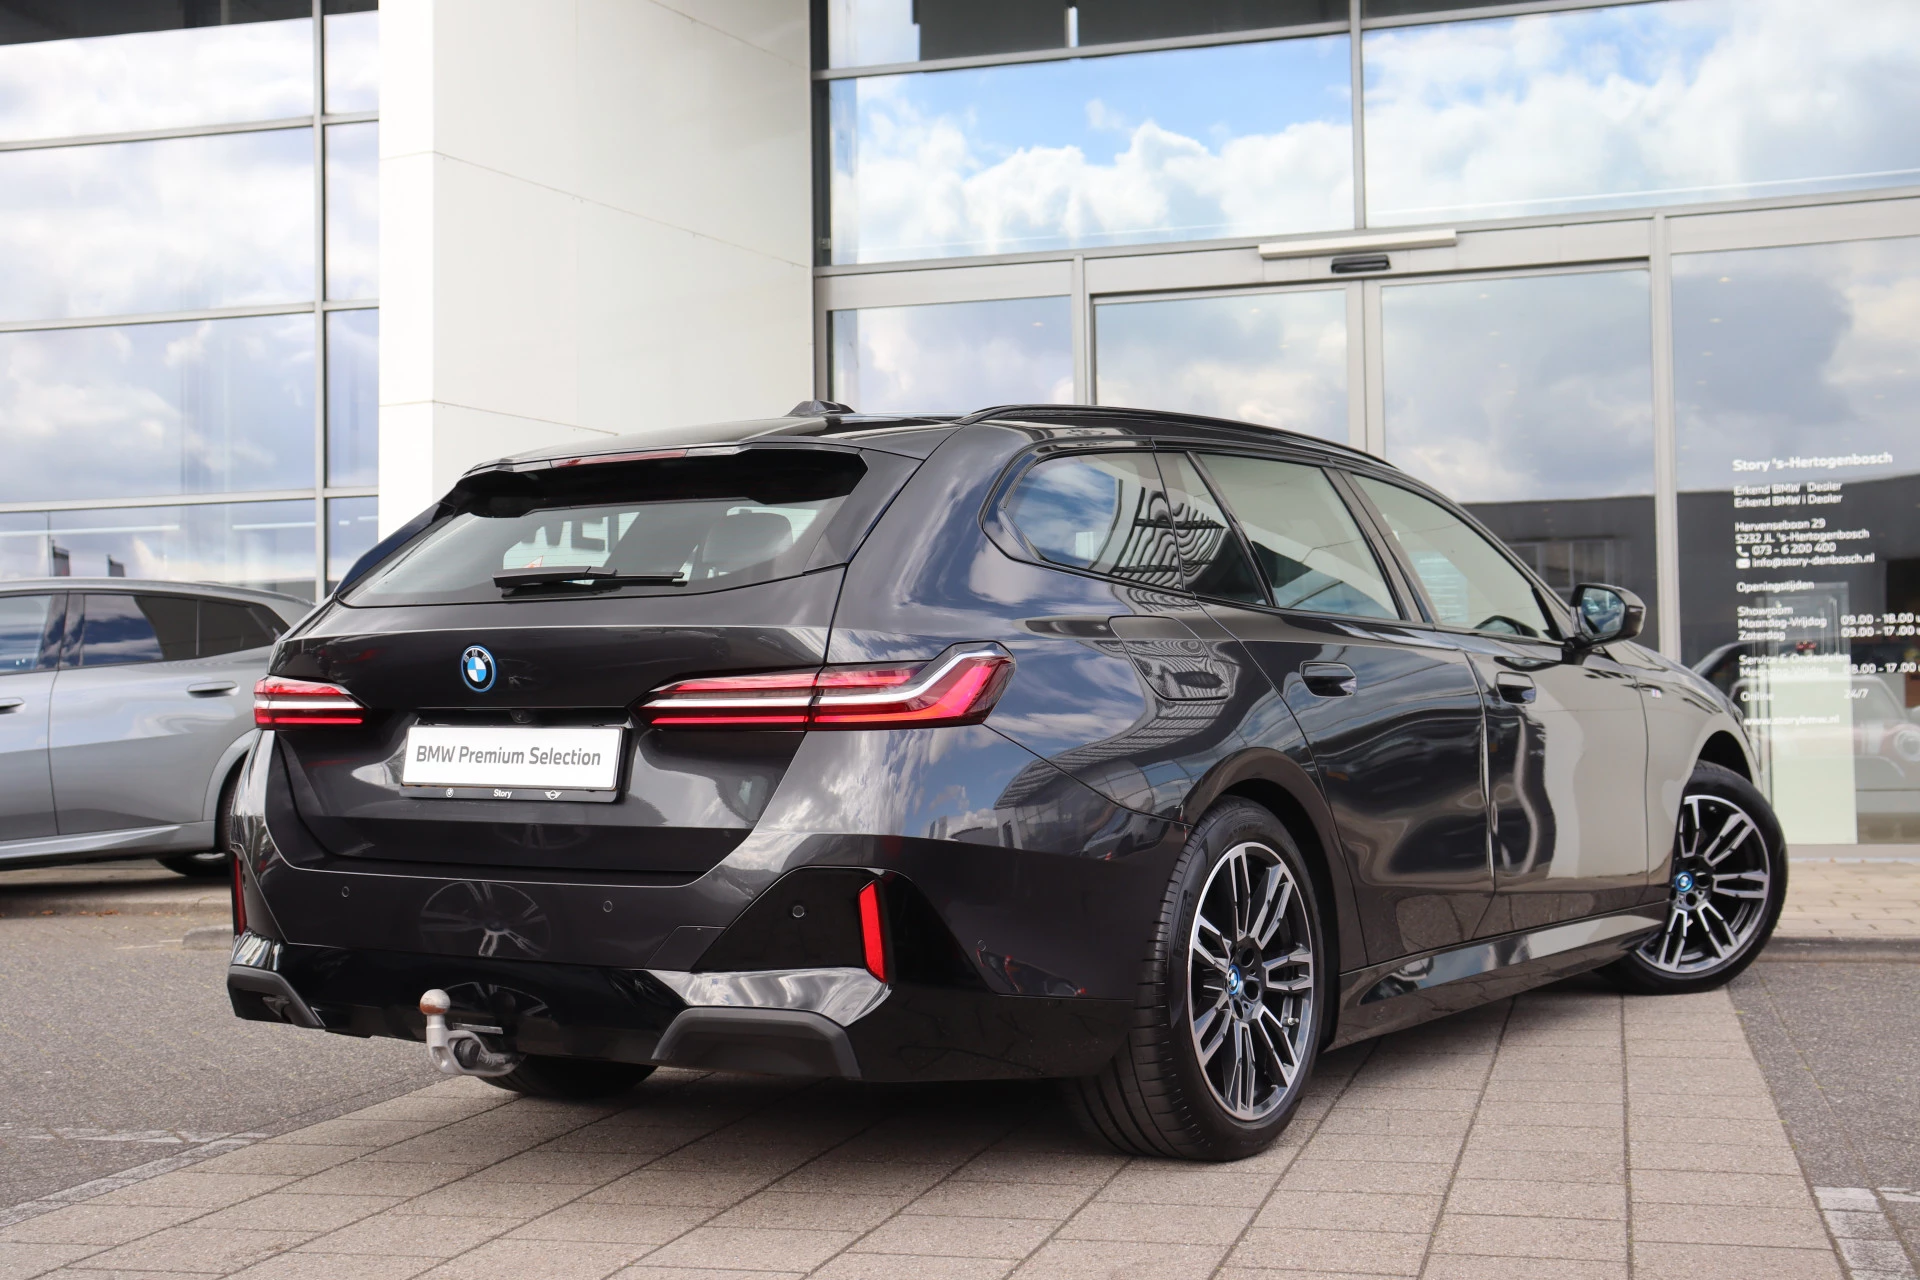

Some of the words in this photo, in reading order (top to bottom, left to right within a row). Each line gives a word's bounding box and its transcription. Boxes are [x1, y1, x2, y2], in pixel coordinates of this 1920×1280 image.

[1732, 459, 1770, 472] Story
[1772, 451, 1893, 470] 's-Hertogenbosch
[1733, 485, 1770, 496] Erkend
[1772, 483, 1800, 494] BMW
[1807, 481, 1842, 493] Dealer
[1734, 497, 1771, 508] Erkend
[1772, 495, 1801, 507] BMW
[1807, 493, 1842, 505] Dealer
[1735, 520, 1810, 532] Hervensebaan
[1811, 518, 1826, 529] 29
[1735, 533, 1761, 544] 5232
[1763, 533, 1775, 544] JL
[1776, 528, 1870, 544] 's-Hertogenbosch
[1752, 544, 1772, 556] 073
[1781, 543, 1789, 554] 6
[1790, 543, 1812, 554] 200
[1814, 542, 1836, 553] 400
[1736, 580, 1815, 593] Openingstijden
[1737, 606, 1793, 617] Showroom
[1840, 614, 1874, 625] 09.00
[1882, 613, 1914, 624] 18.00
[1738, 630, 1786, 642] Zaterdag
[1841, 626, 1875, 637] 09.00
[1738, 654, 1778, 665] Service
[416, 745, 456, 763] BMW
[458, 746, 525, 765] Premium
[529, 746, 601, 766] Selection
[493, 788, 512, 799] Story
